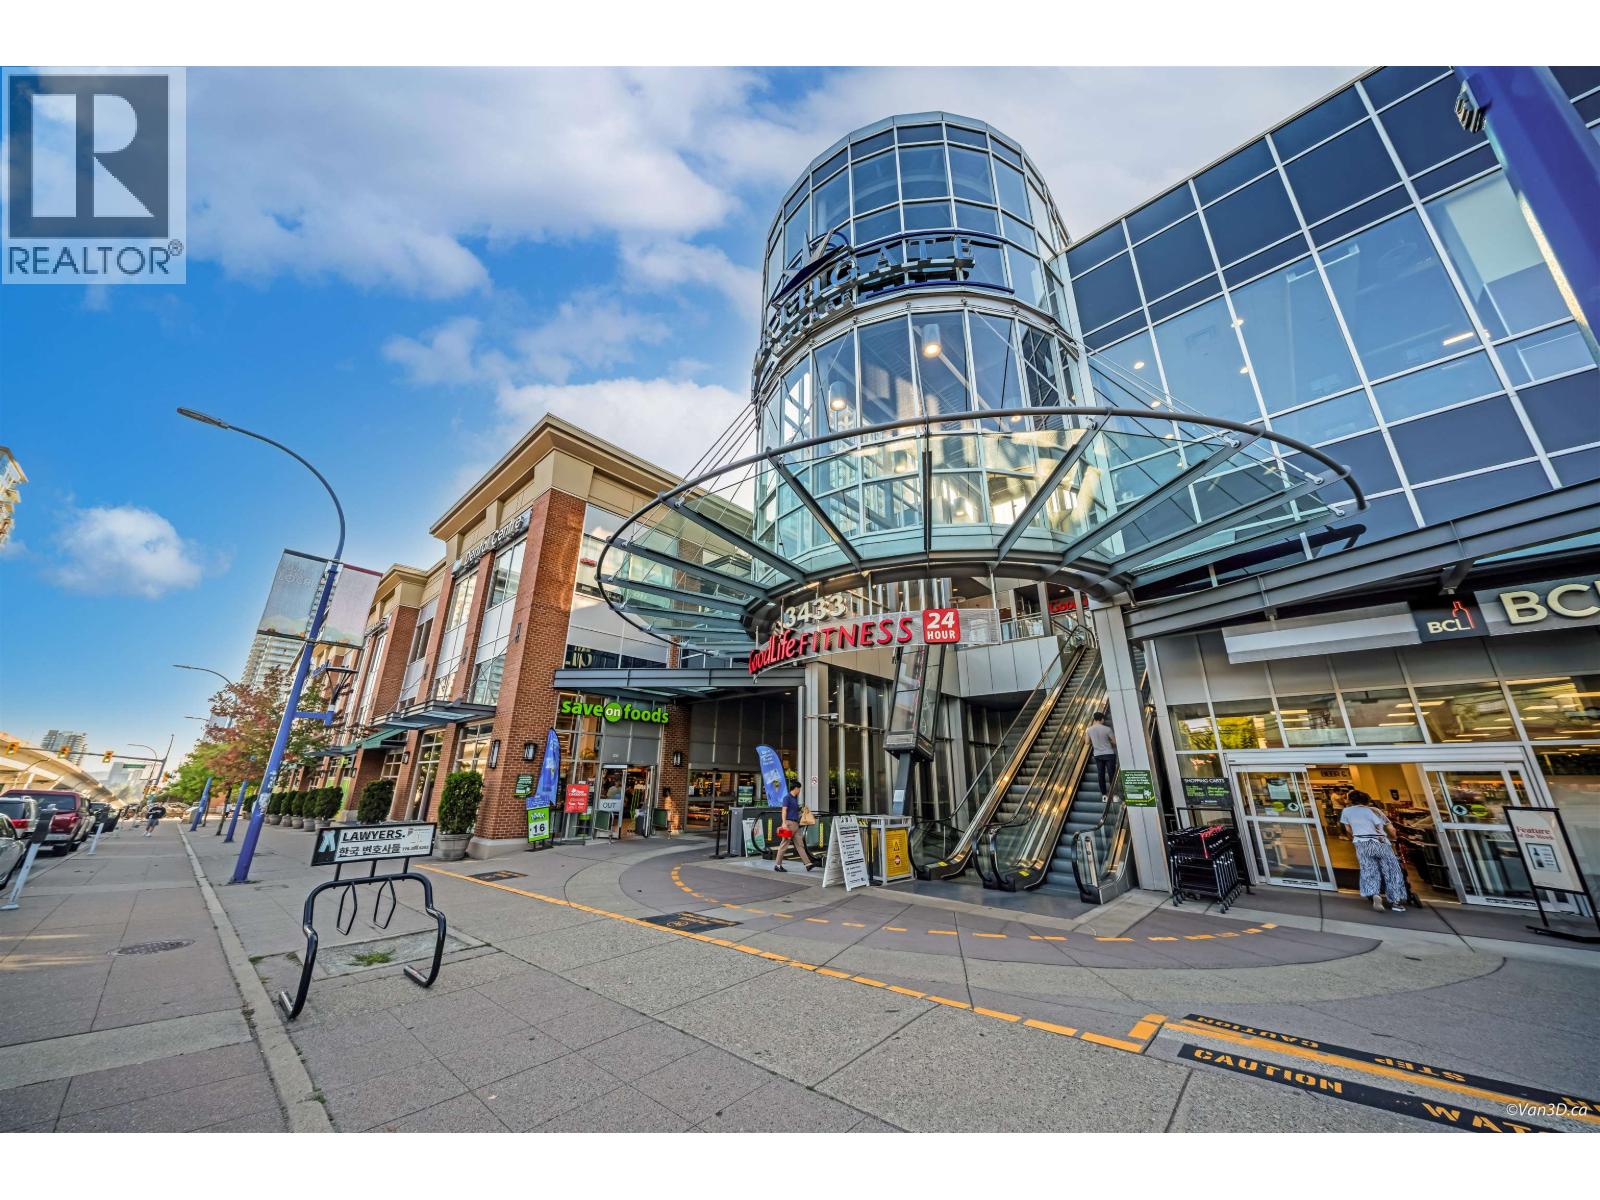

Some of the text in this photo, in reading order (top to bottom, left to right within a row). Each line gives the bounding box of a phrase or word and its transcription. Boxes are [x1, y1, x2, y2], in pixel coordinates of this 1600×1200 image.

[783, 591, 847, 628] 3433
[1500, 581, 1600, 625] BC
[926, 611, 955, 629] 24
[1426, 619, 1471, 634] BCL
[798, 616, 914, 655] FITNESS
[927, 630, 956, 640] HOUR
[561, 700, 670, 724] save on foods
[1516, 826, 1551, 835] Feature
[1196, 1016, 1320, 1049] CAUTION
[1193, 1048, 1343, 1094] CAUTION
[1421, 1102, 1546, 1133] WAT
